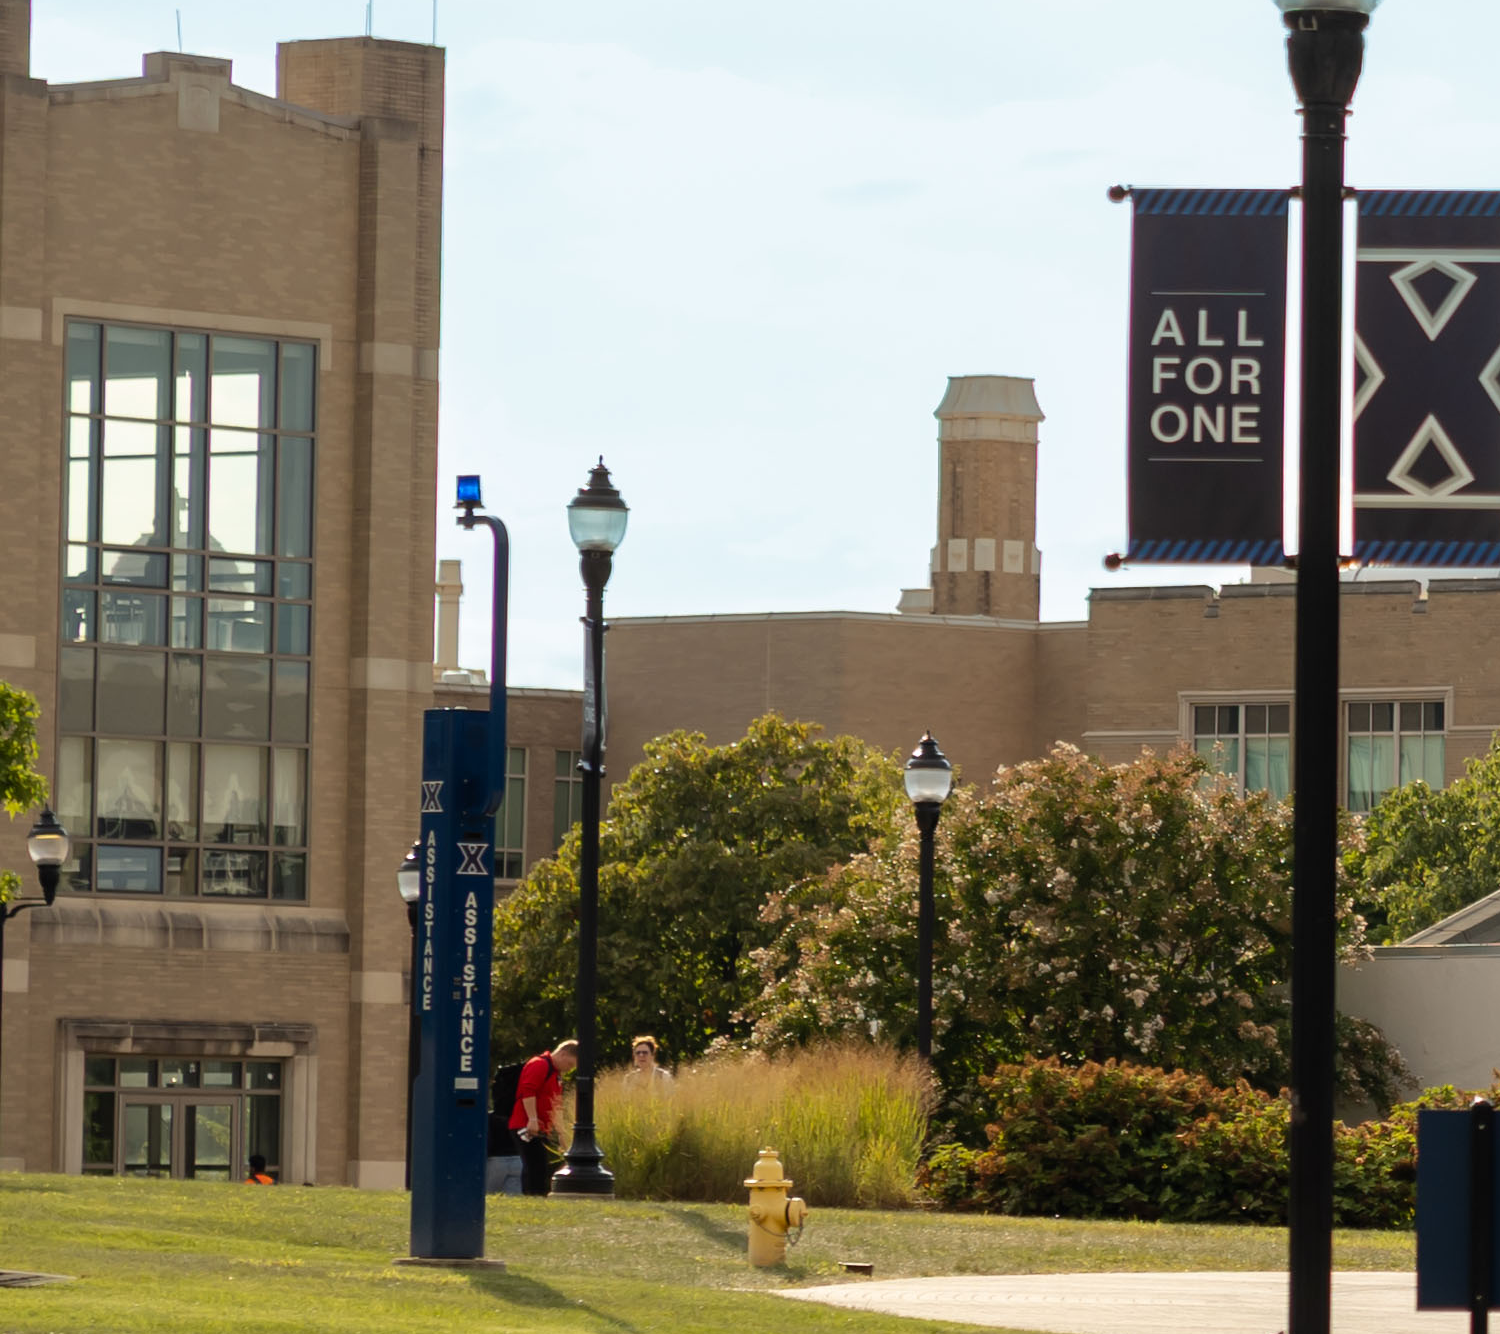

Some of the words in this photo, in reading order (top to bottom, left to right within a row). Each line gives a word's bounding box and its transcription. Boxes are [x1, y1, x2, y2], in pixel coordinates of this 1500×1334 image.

[1151, 308, 1264, 347] ALL
[1152, 357, 1261, 395] FOR
[1150, 405, 1261, 443] ONE
[422, 830, 436, 1011] ASSISTANCE
[460, 891, 478, 1072] ASSISTANCE
